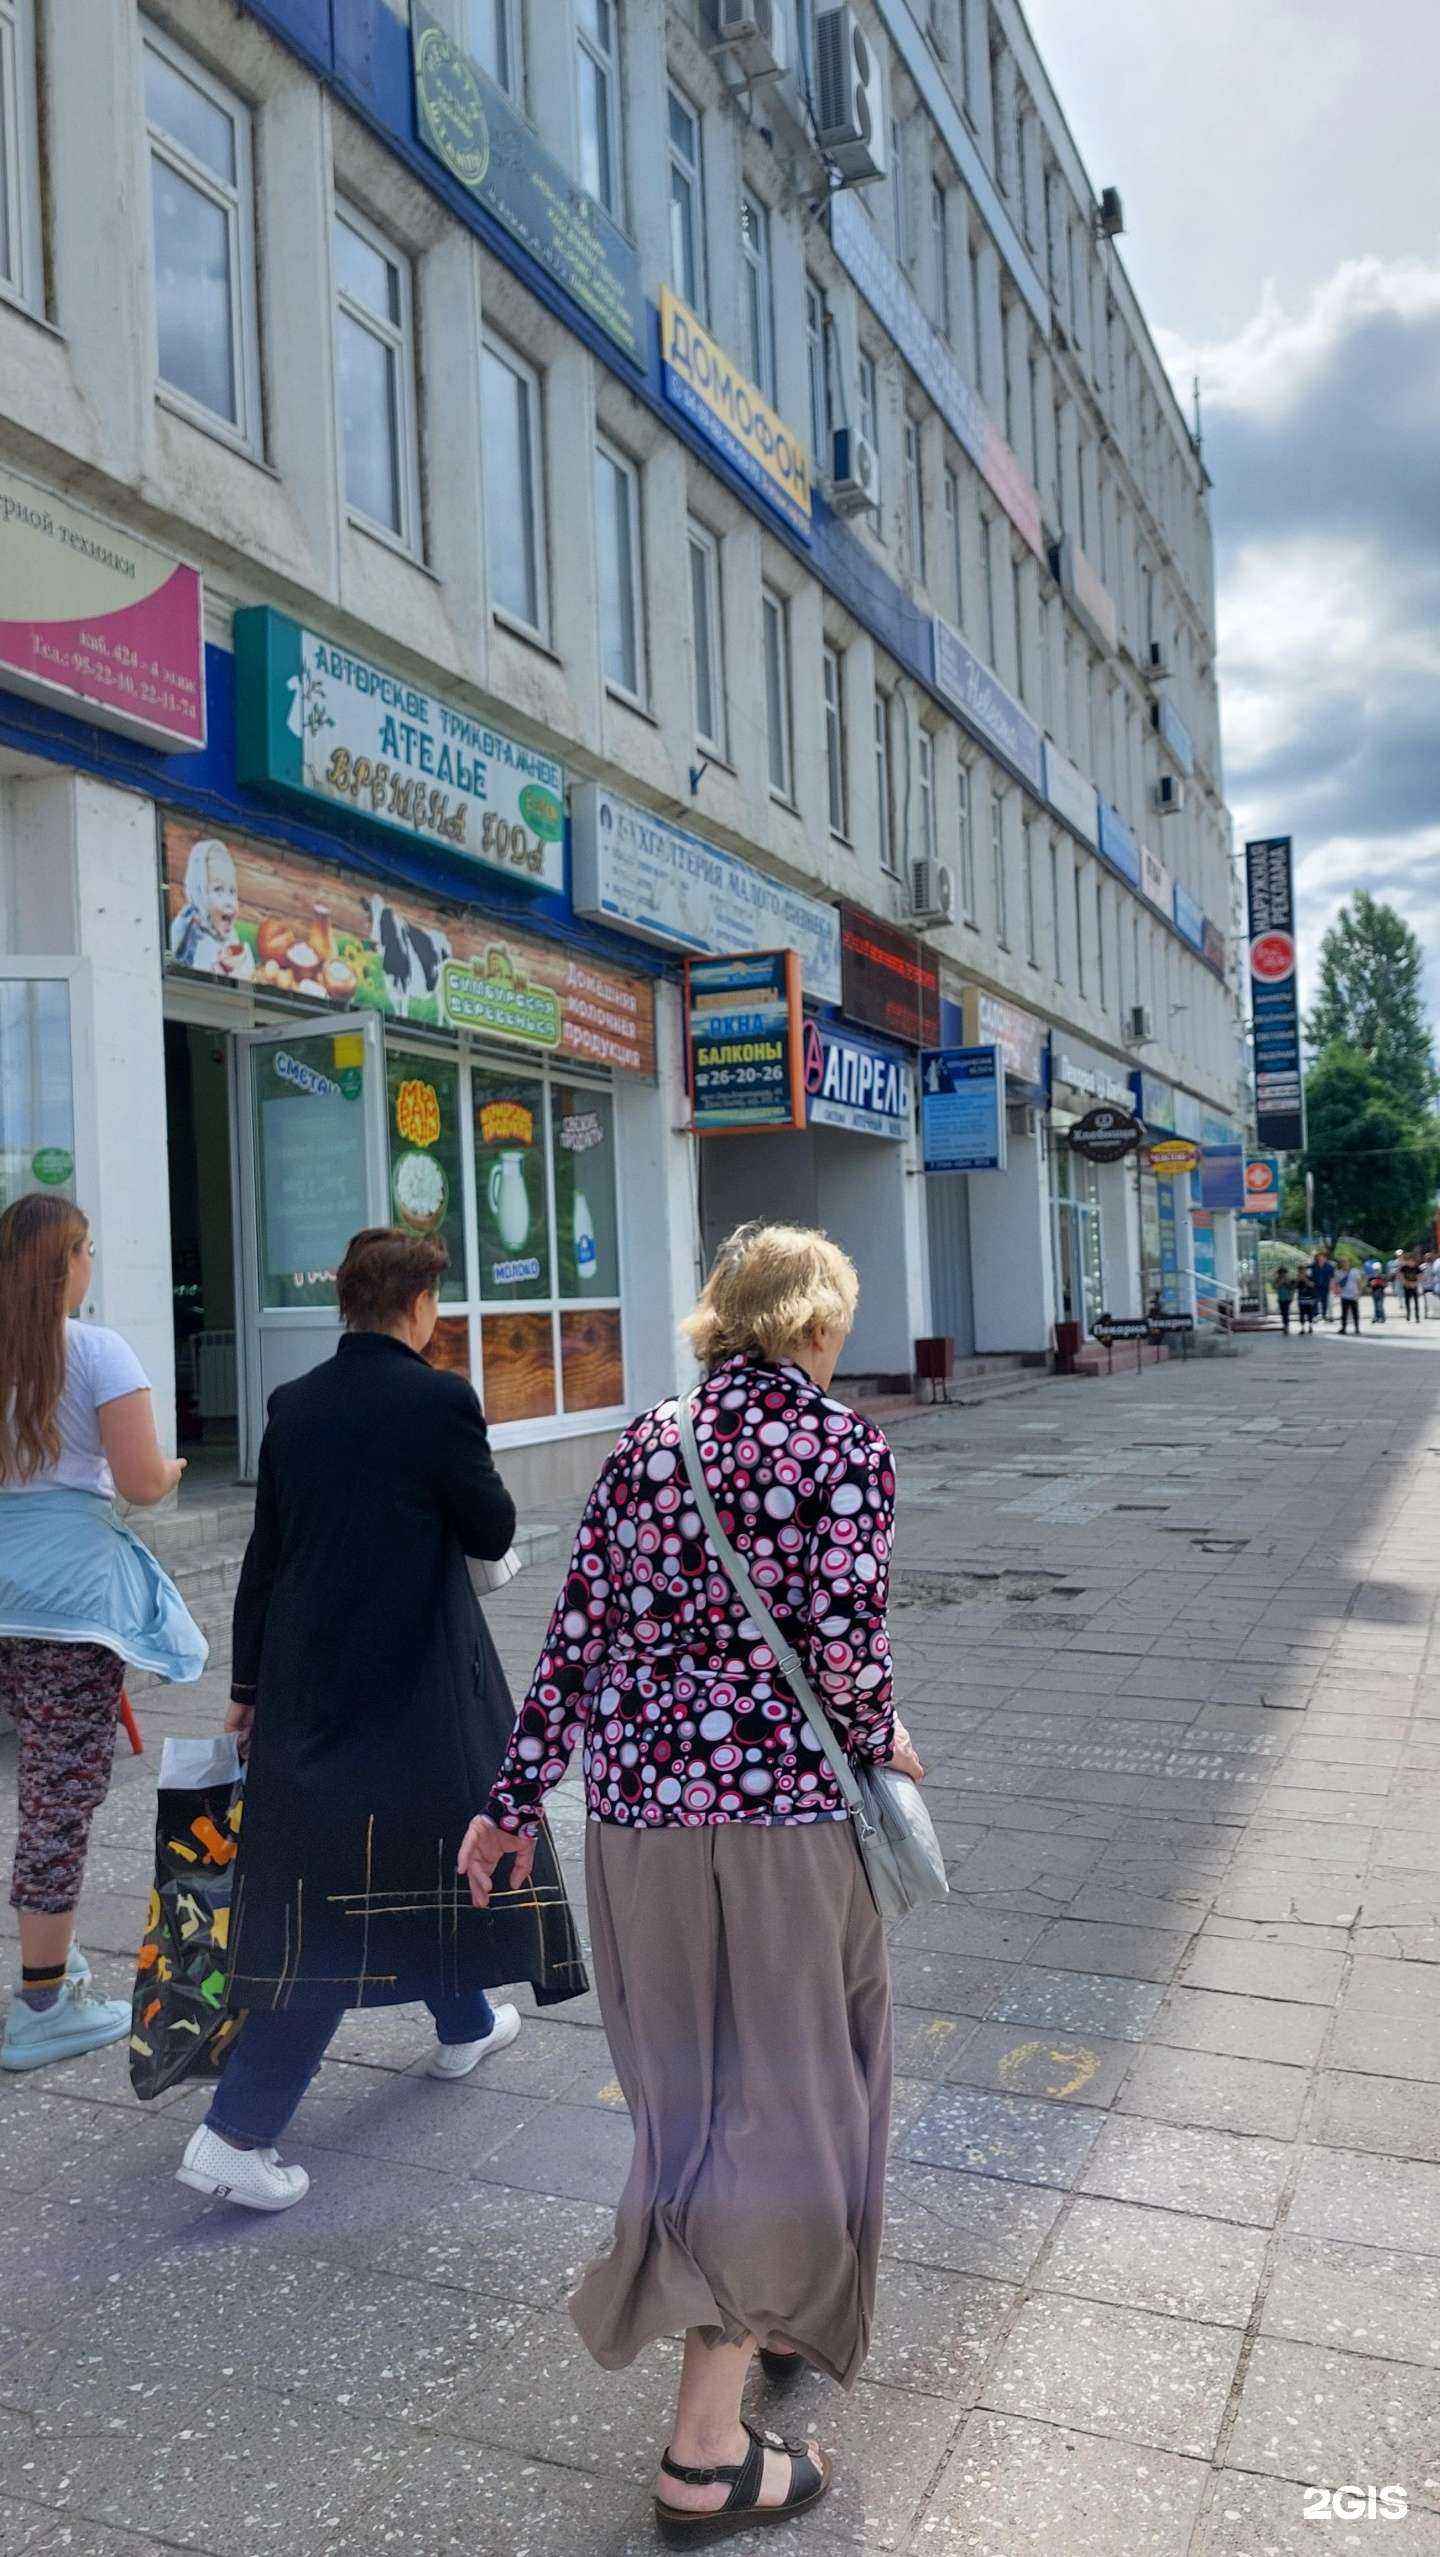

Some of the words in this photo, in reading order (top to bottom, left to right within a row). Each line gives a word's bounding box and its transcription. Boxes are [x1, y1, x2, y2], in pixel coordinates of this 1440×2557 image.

[671, 312, 808, 506] ДОМОФОН
[60, 526, 136, 579] техники
[315, 643, 429, 724] АВТОРСКОЕ
[440, 709, 560, 790] ТРИКОТАЖНОЕ
[379, 715, 488, 799] АТЕЛЬЕ
[326, 746, 468, 846] ВРЕМЕНА
[482, 811, 545, 875] ГОДА
[698, 1041, 783, 1066] БАЛКОНЫ
[709, 1013, 766, 1037] ОКНА
[711, 1065, 783, 1084] 26-20-26
[823, 1045, 908, 1117] АПРЕЛЬ
